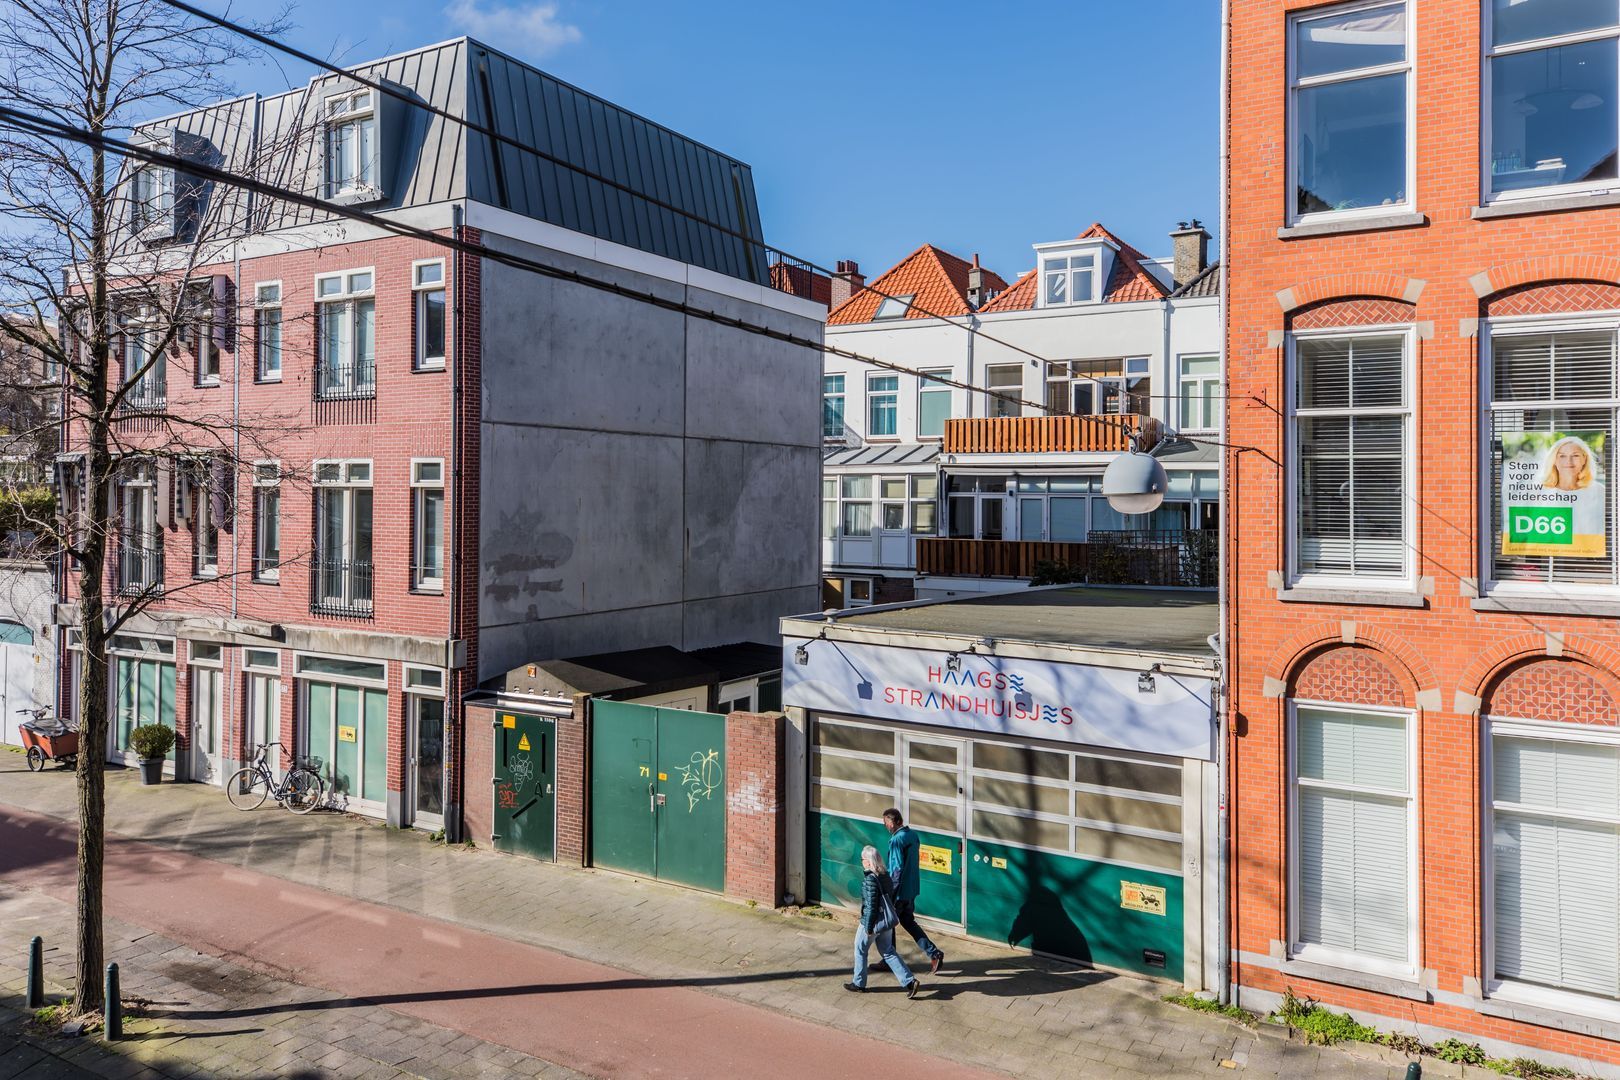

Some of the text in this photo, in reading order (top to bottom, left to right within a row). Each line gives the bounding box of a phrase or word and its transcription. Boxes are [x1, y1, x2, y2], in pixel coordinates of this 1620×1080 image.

[1509, 461, 1538, 470] Stem
[1508, 473, 1535, 481] voor
[1508, 482, 1544, 491] nieuw
[1508, 493, 1577, 503] leiderschap
[1515, 515, 1565, 534] D66
[884, 687, 1074, 725] STRANDHUISJES
[640, 766, 649, 777] 71
